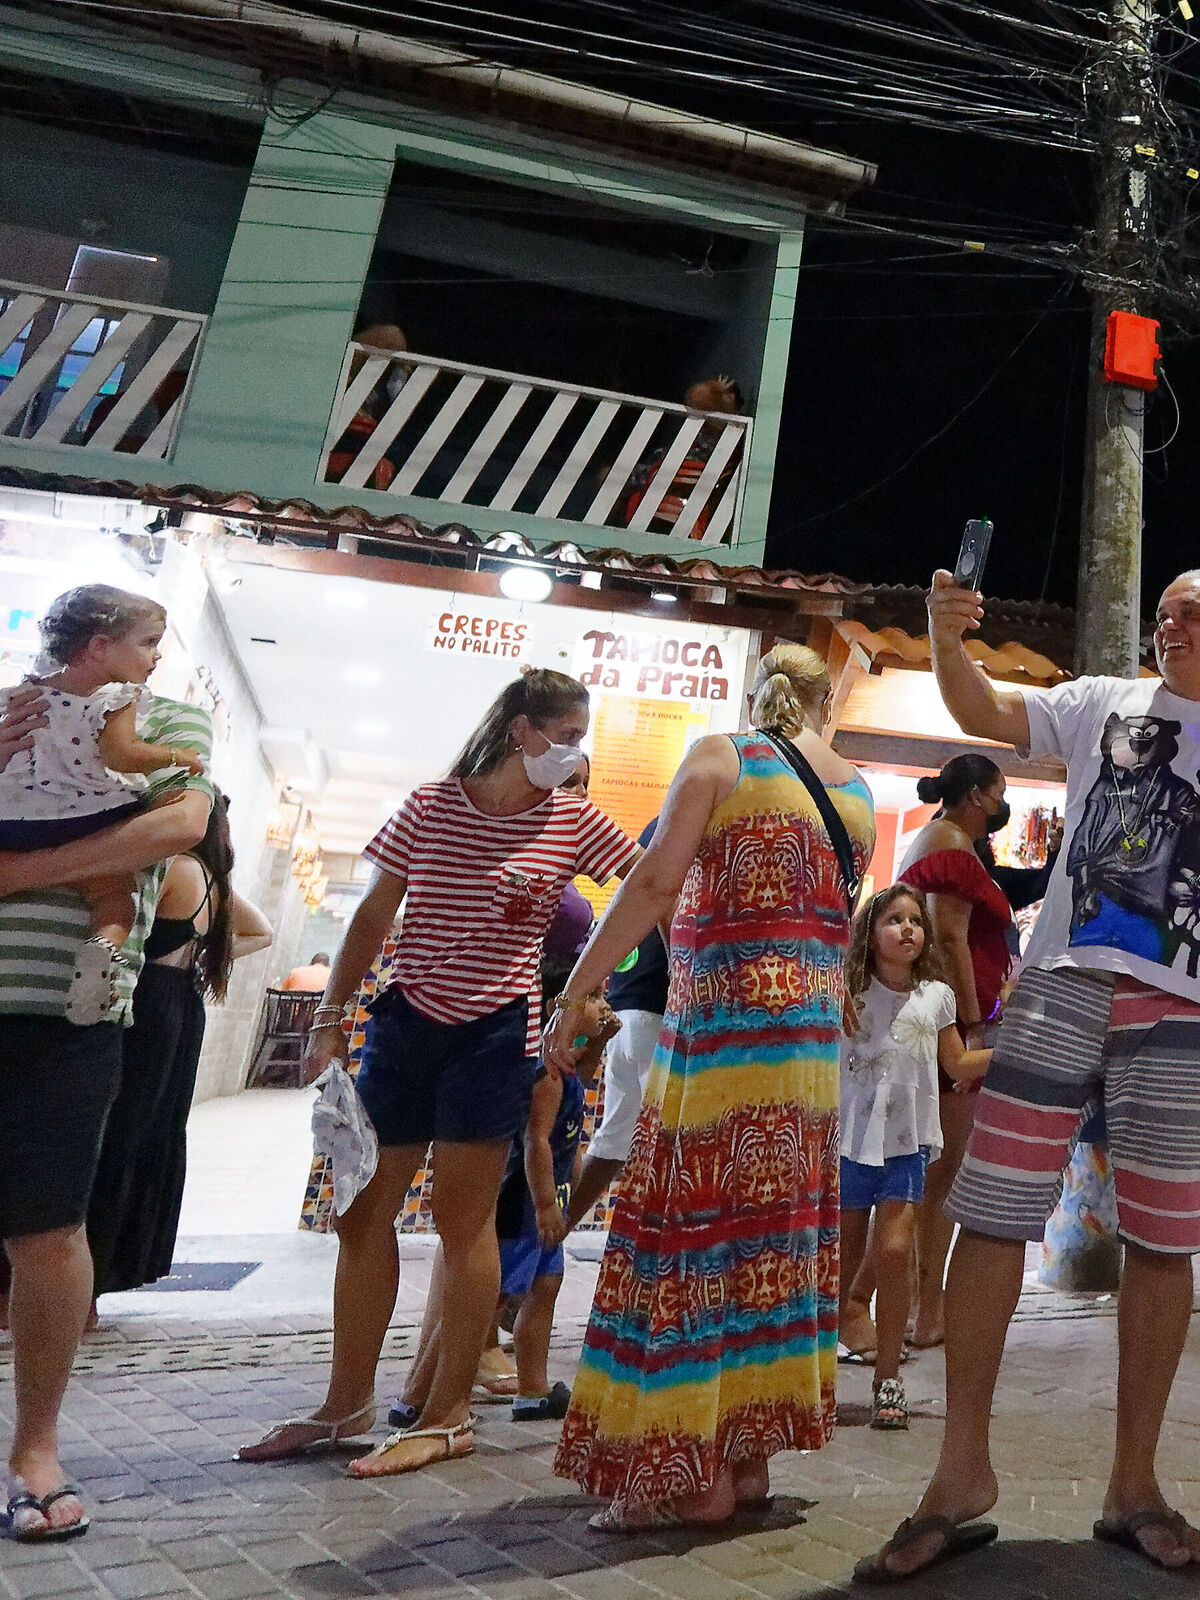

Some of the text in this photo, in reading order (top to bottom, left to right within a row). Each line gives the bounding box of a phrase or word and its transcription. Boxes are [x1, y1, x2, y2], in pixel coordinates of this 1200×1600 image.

[438, 613, 528, 641] CREPES
[433, 636, 521, 658] NO PALITO
[582, 629, 723, 669] TAPIOCA
[578, 663, 730, 701] da Praia
